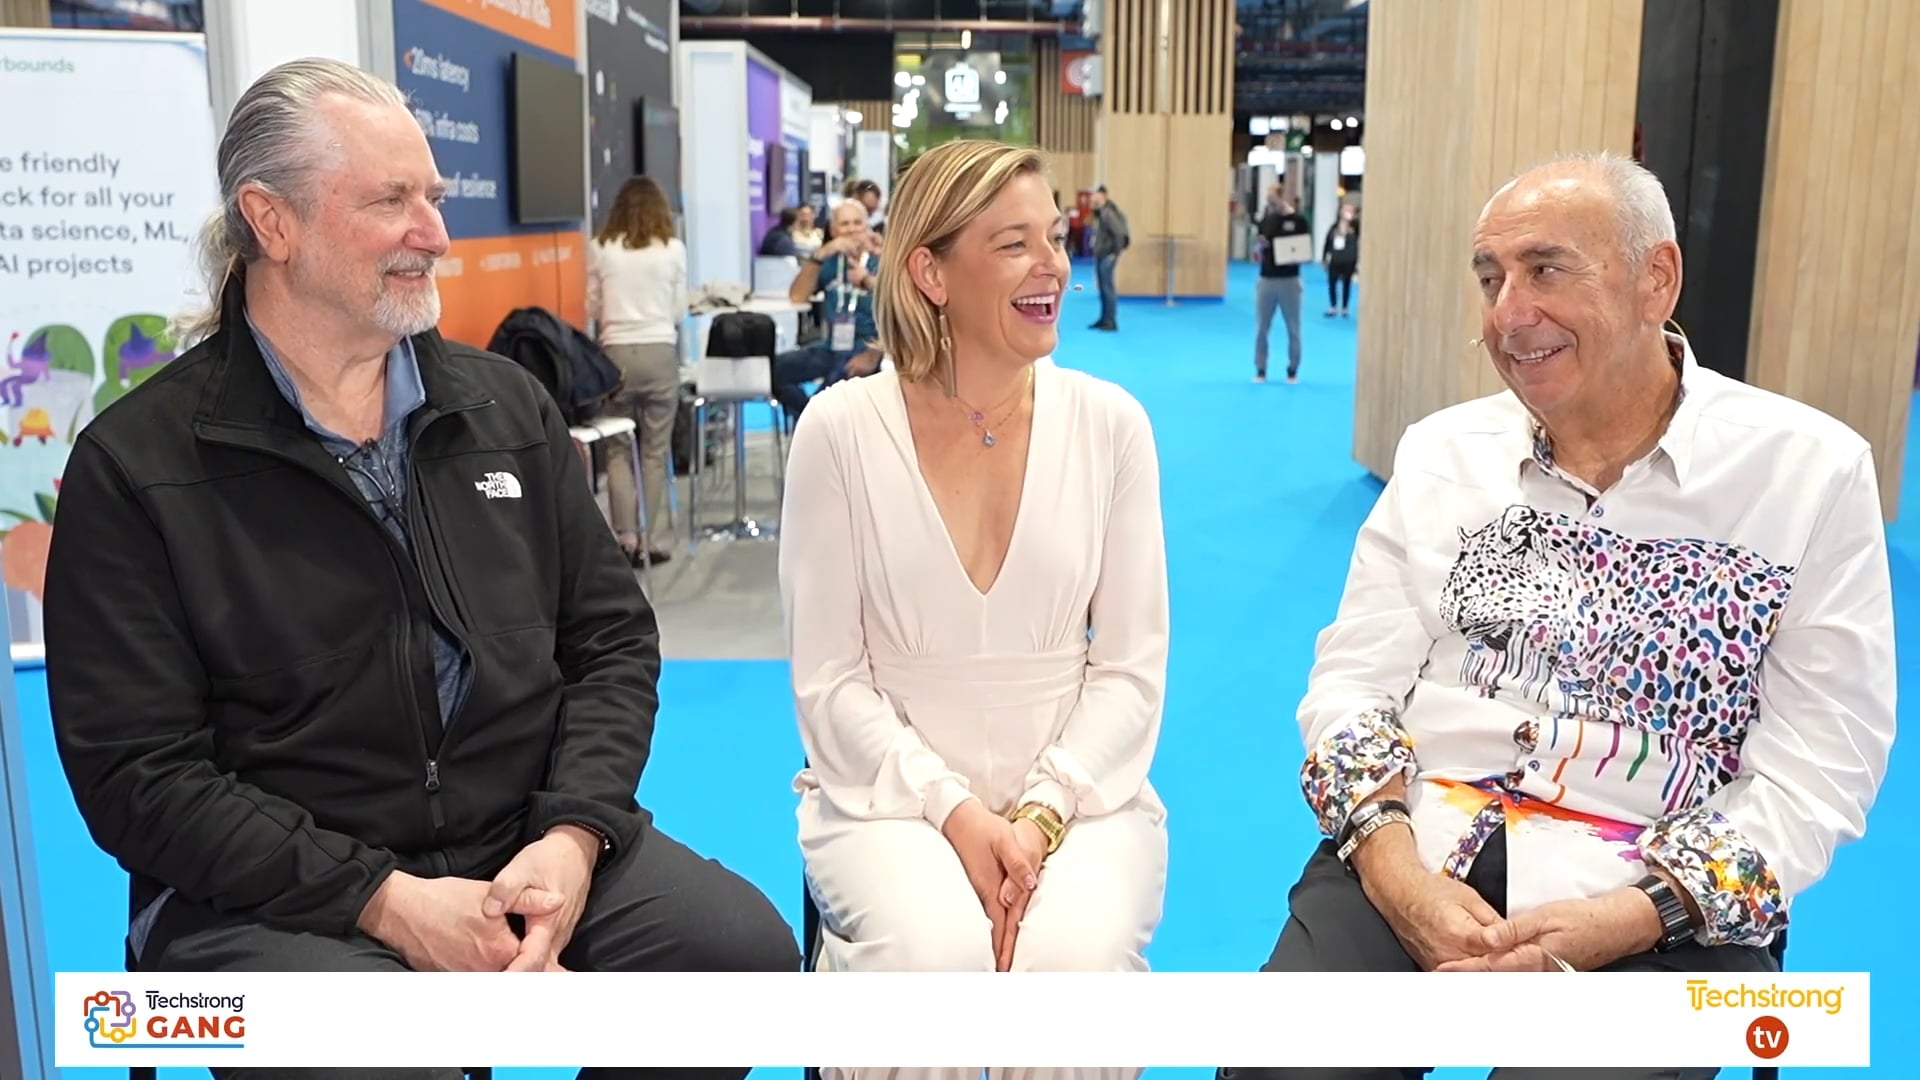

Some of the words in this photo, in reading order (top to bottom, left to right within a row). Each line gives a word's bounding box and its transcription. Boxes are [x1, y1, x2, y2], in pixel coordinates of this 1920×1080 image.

[0, 55, 76, 74] bounds
[438, 52, 470, 92] latency
[21, 151, 120, 178] friendly
[2, 186, 34, 207] ck
[41, 186, 76, 207] for
[84, 187, 112, 207] all
[119, 191, 175, 212] your
[31, 219, 138, 244] science,
[144, 220, 189, 244] ML,
[27, 252, 134, 279] projects
[474, 480, 507, 491] NORTH
[484, 472, 506, 481] THE
[485, 488, 509, 499] FACE
